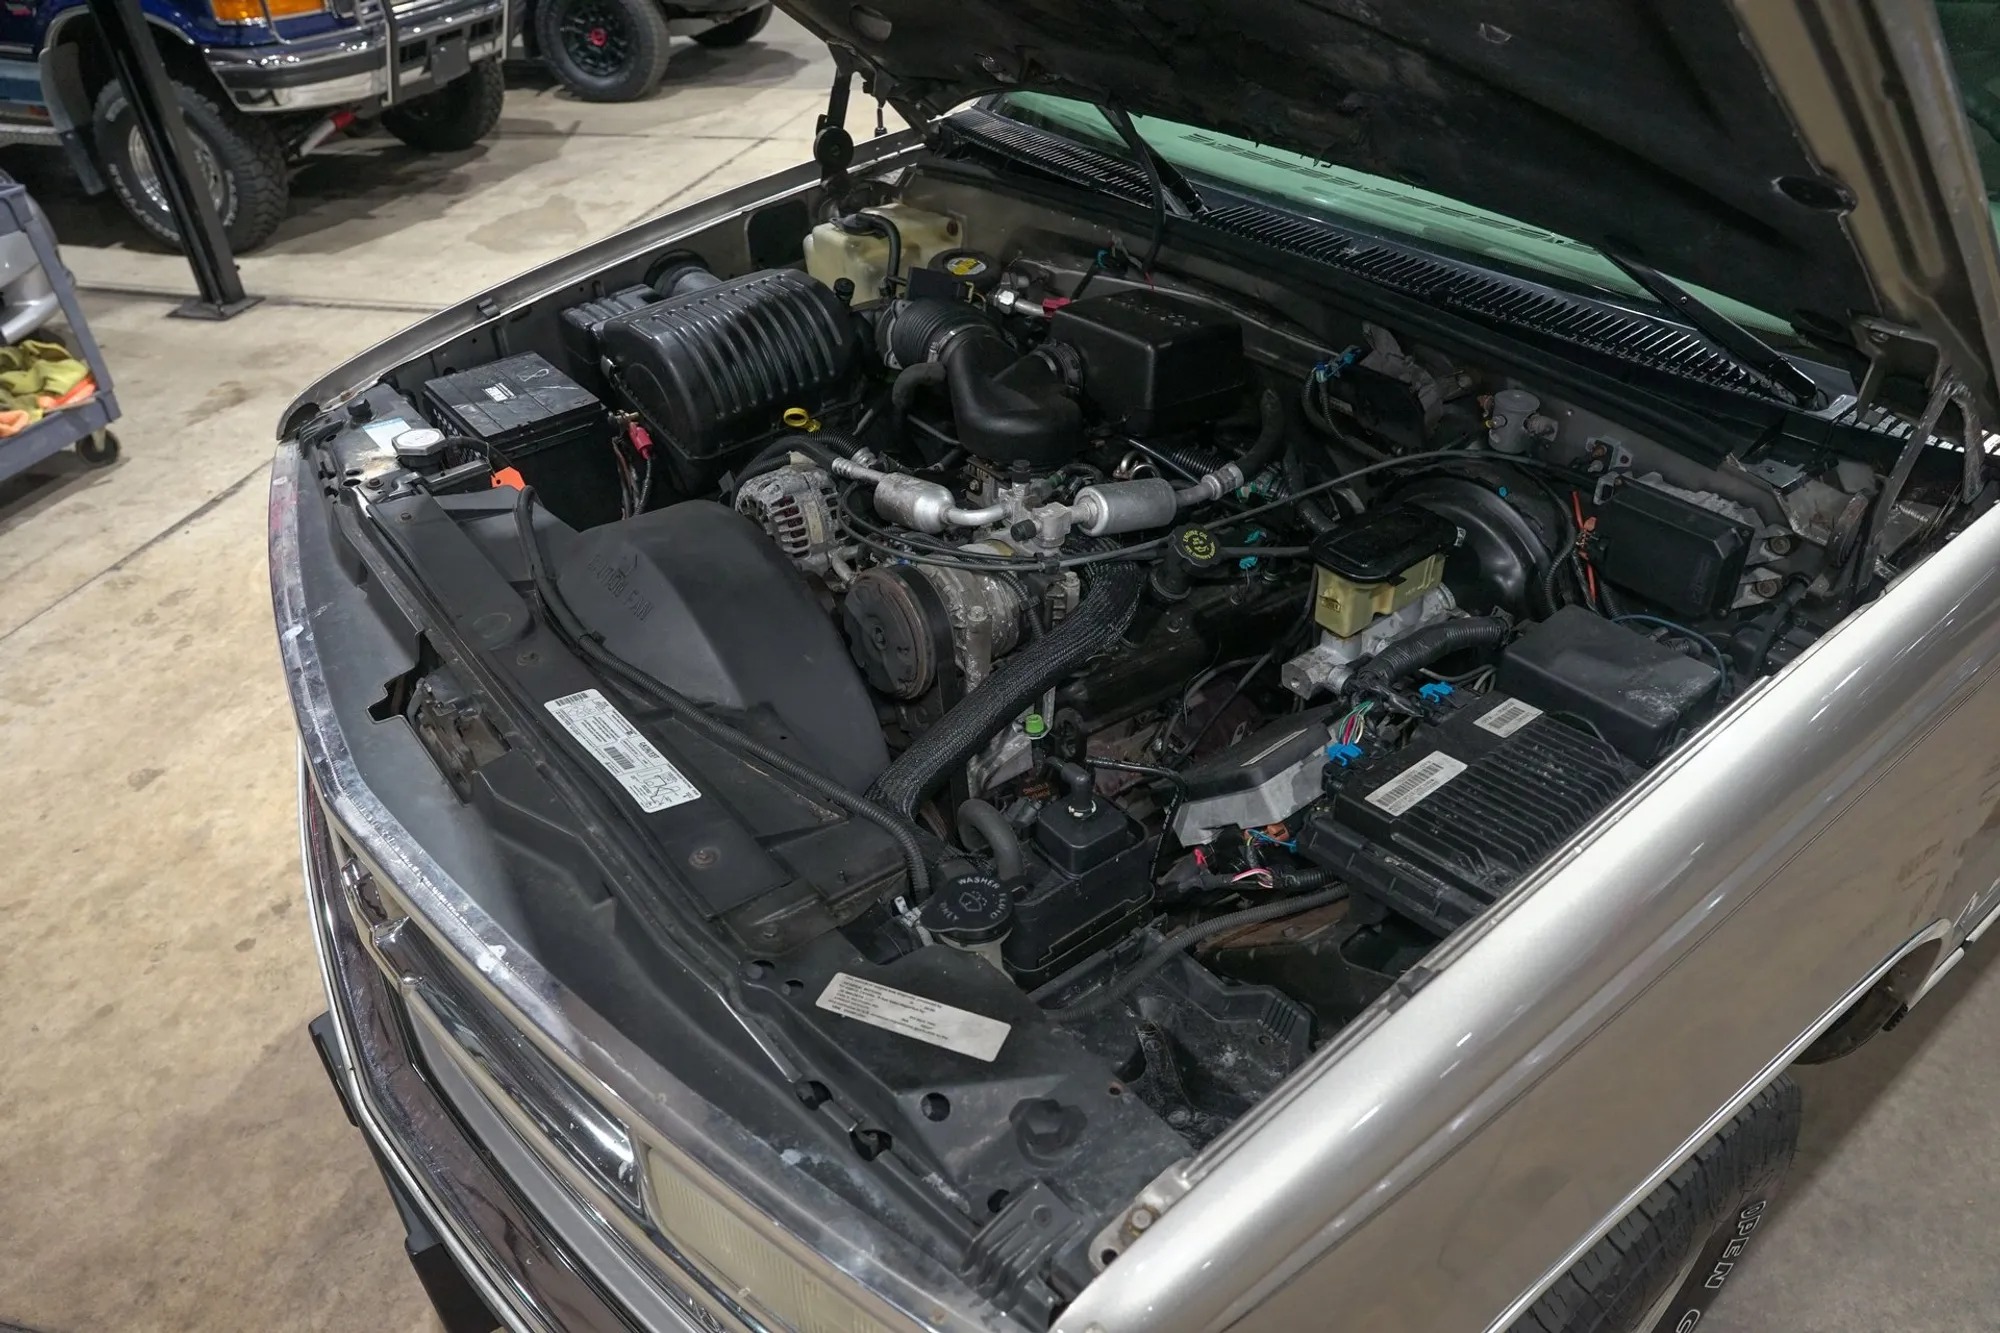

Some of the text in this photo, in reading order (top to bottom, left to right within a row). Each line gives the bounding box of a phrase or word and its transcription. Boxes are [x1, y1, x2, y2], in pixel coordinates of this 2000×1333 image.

[957, 876, 1007, 919] WASHER FLUID
[1704, 1200, 1767, 1289] OPEN
